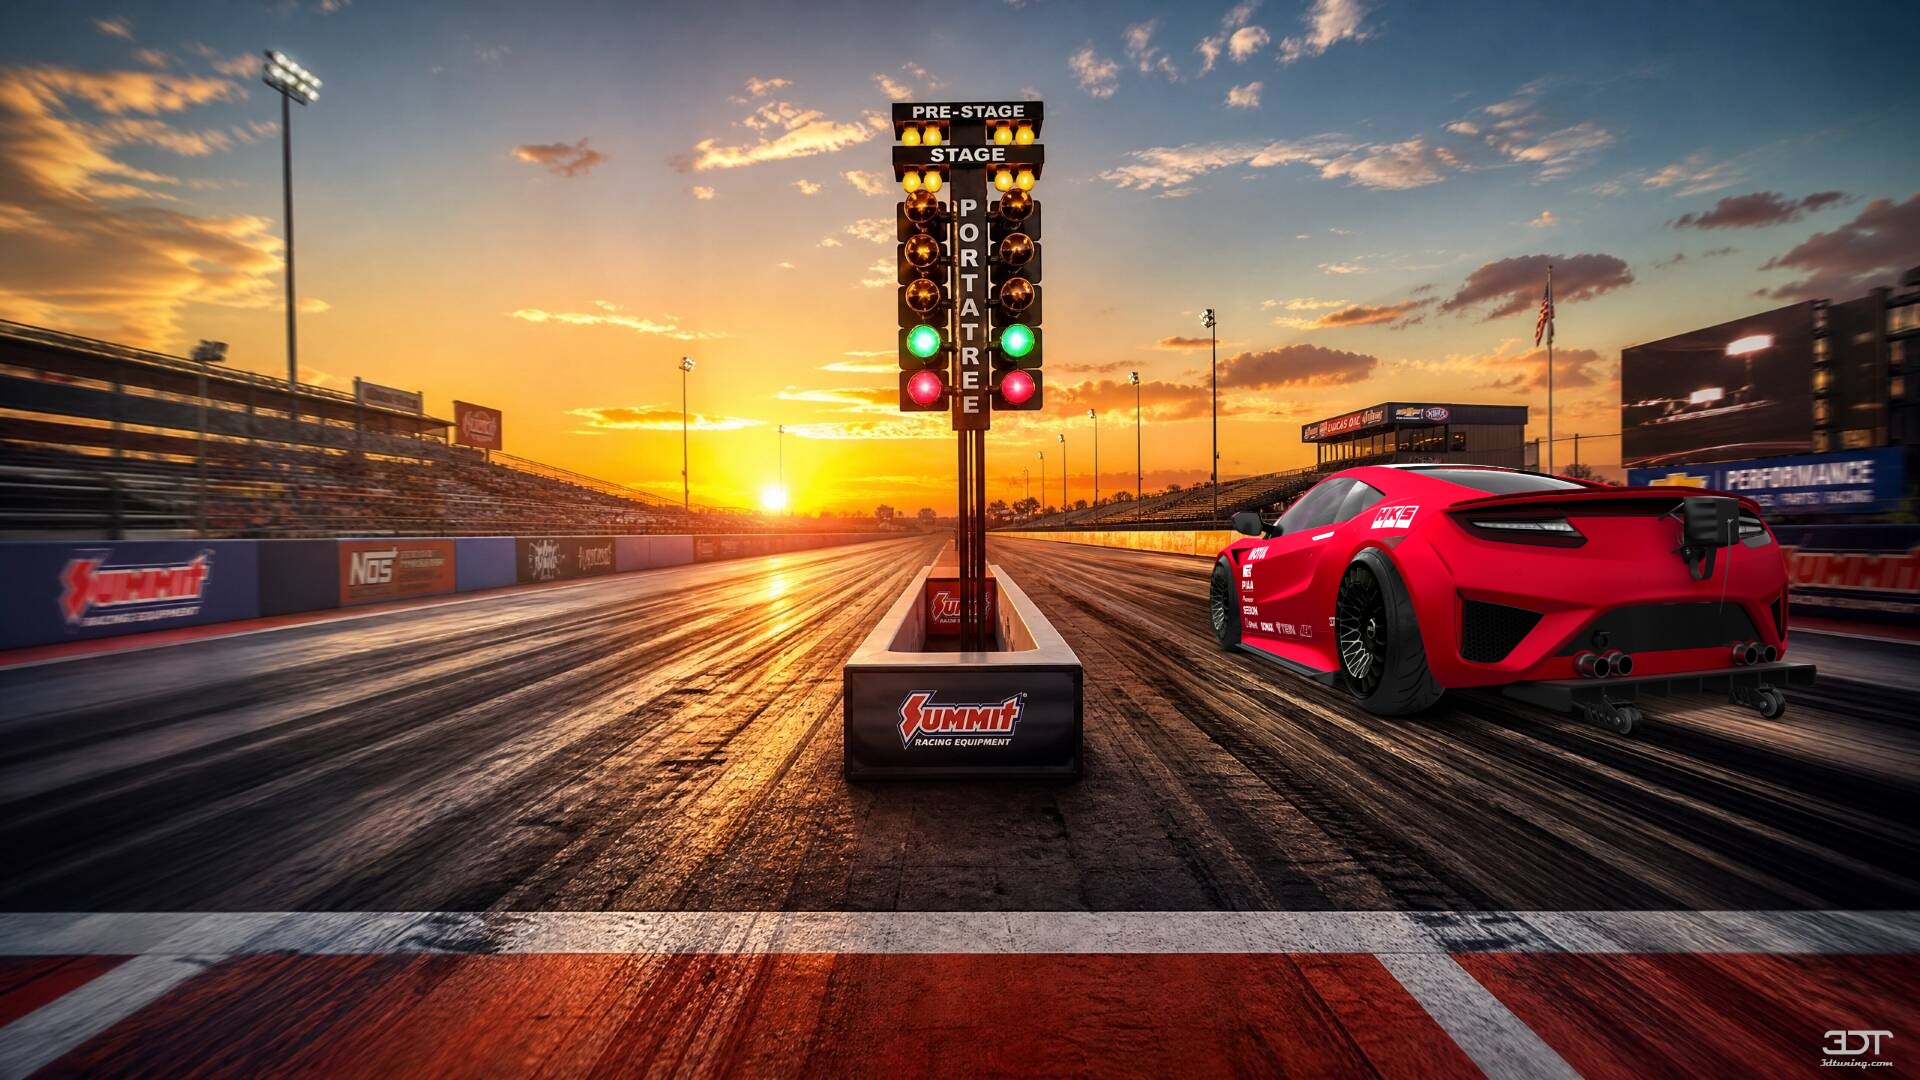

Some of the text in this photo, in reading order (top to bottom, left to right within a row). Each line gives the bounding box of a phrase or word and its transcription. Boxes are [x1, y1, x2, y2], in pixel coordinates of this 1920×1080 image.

[912, 105, 1025, 119] PRE-STAGE
[930, 148, 1006, 162] STAGE
[959, 199, 980, 414] PORTATREE
[1725, 460, 1875, 491] PERFORMANCE
[1371, 505, 1420, 529] HKS
[349, 546, 398, 586] NOS
[899, 691, 1023, 746] SUMMIT
[915, 738, 1012, 747] RACING EQUIPMENT
